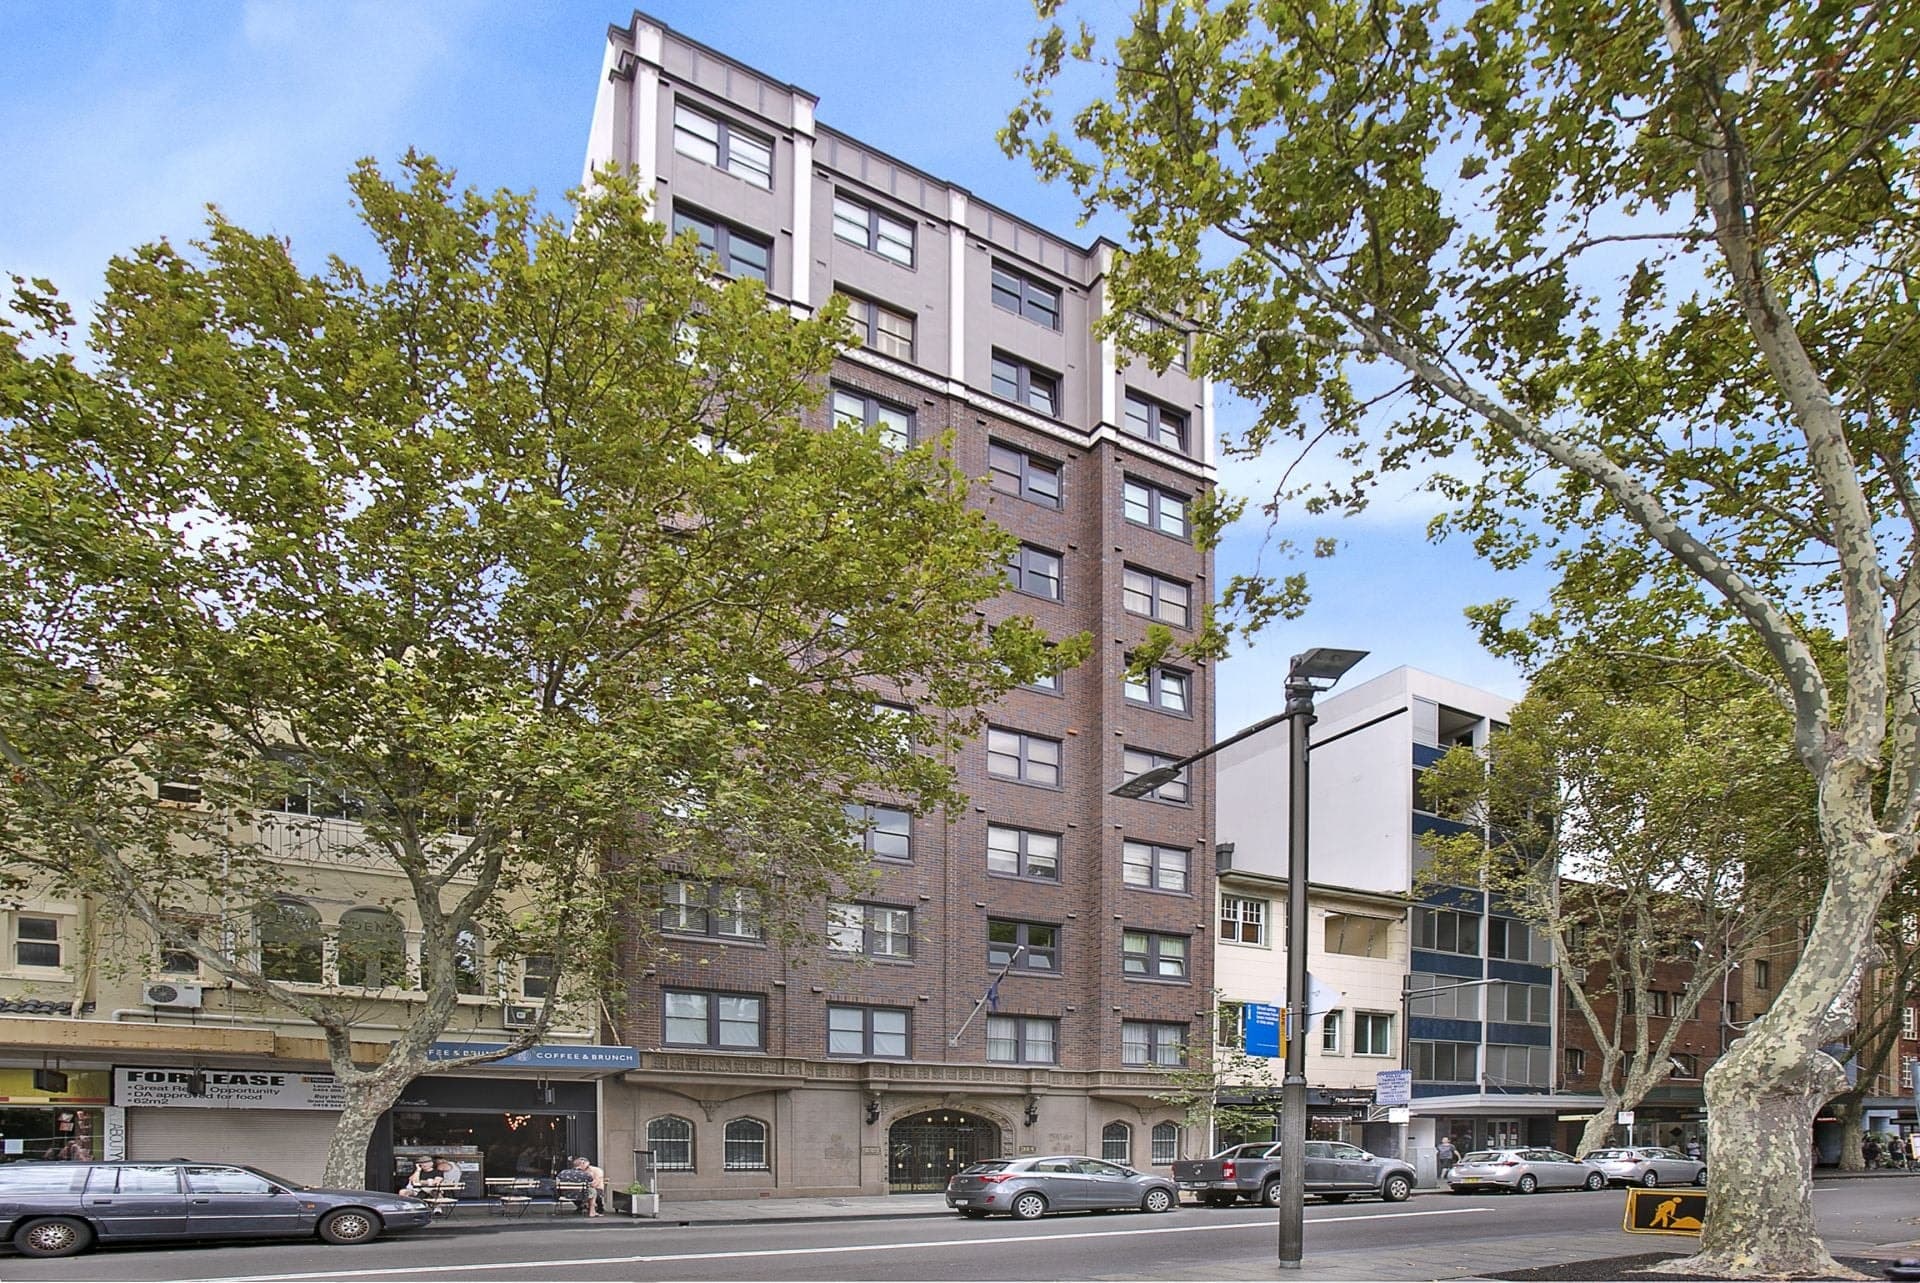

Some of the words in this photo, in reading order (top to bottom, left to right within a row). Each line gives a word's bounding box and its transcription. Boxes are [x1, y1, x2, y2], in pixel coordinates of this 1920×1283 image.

[536, 1052, 580, 1060] COFFEE
[128, 1071, 194, 1083] FOR
[134, 1084, 168, 1092] Great
[210, 1086, 281, 1097] Opportunity
